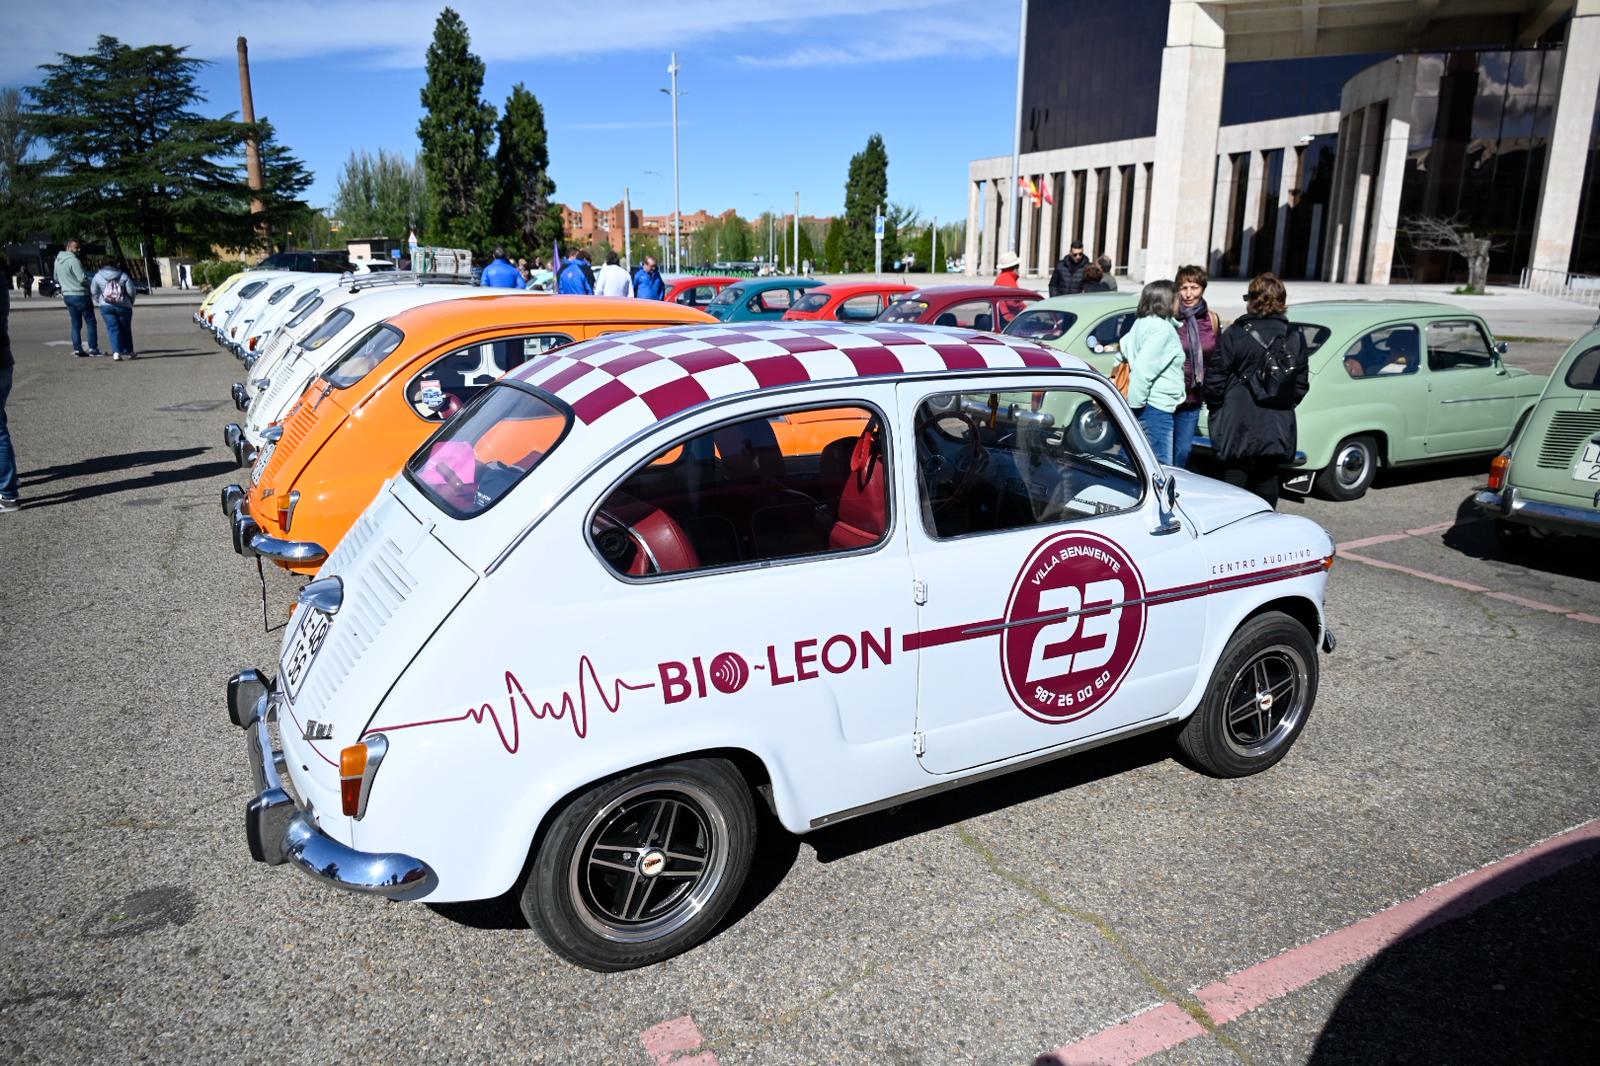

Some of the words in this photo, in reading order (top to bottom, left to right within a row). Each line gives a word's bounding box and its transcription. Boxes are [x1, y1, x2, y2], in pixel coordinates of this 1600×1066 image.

[1032, 556, 1061, 585] VILLA
[1060, 546, 1121, 573] BENAVENTE
[1212, 560, 1255, 574] CENTRO
[1263, 550, 1311, 564] AUDITIVO
[1025, 579, 1125, 684] 23
[1035, 685, 1056, 704] 987
[1058, 694, 1074, 706] 26
[1077, 685, 1093, 702] 00
[1095, 670, 1111, 689] 60
